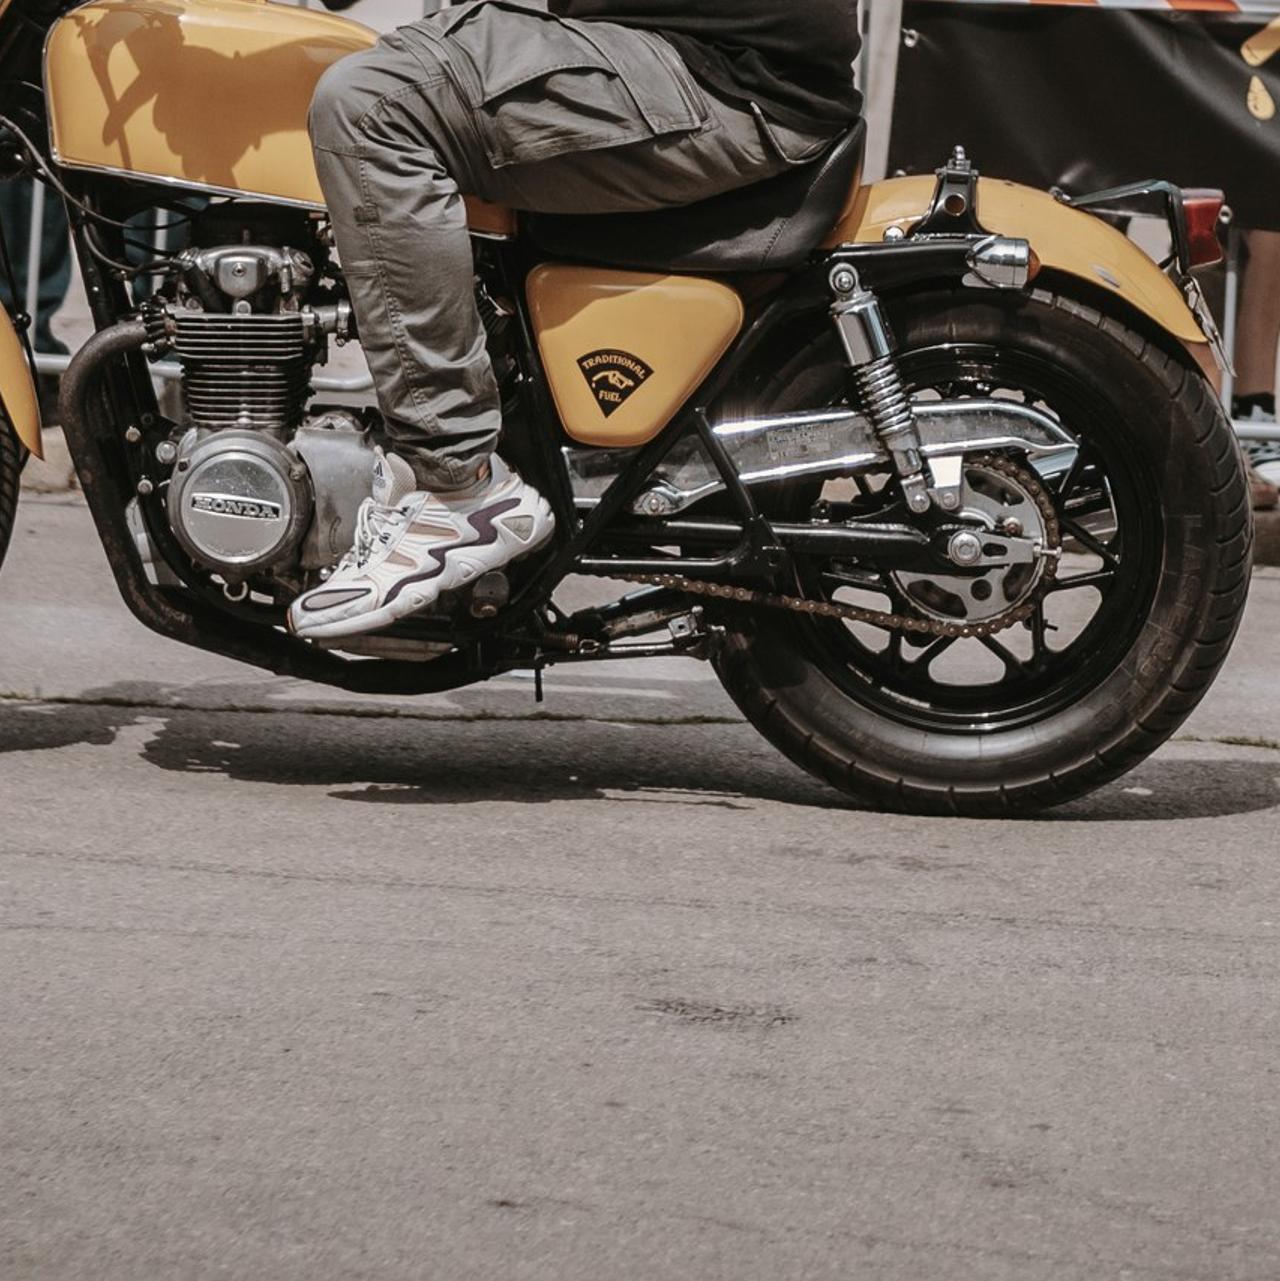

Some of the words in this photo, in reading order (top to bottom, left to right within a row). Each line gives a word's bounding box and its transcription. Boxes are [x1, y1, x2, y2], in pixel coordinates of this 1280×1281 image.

[581, 354, 646, 380] TRADITIONAL
[599, 390, 622, 403] FUEL
[193, 496, 278, 519] HONDA
